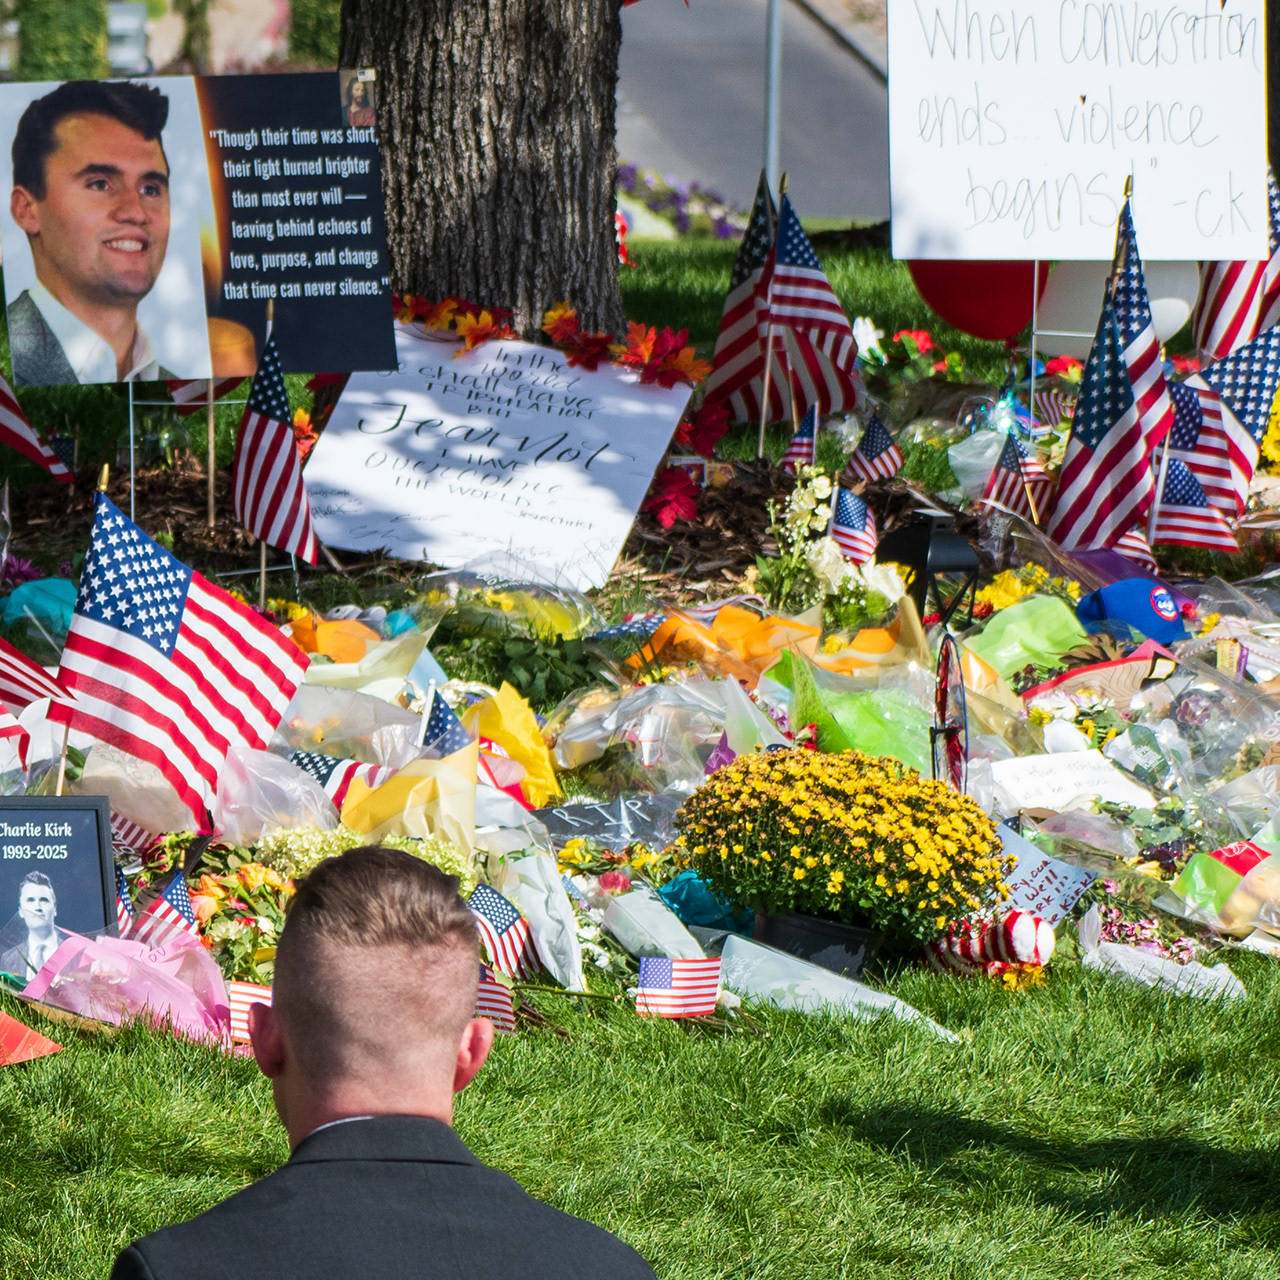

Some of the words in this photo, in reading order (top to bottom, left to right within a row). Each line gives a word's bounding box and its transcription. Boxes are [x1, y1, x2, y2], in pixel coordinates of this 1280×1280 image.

[913, 0, 1038, 64] When
[1054, 84, 1219, 149] violence
[209, 129, 259, 150] "Though
[261, 127, 289, 147] their
[291, 127, 318, 146] time
[321, 128, 344, 145] was
[346, 126, 380, 146] short,
[223, 160, 251, 179] their
[253, 158, 281, 181] light
[283, 157, 323, 177] burned
[325, 156, 371, 179] brighter
[232, 190, 259, 209] than
[261, 189, 290, 207] most
[293, 189, 319, 206] ever
[321, 187, 342, 205] will
[231, 220, 275, 242] leaving
[276, 218, 315, 239] behind
[317, 217, 359, 236] echoes
[360, 216, 372, 235] of
[229, 251, 260, 271] love,
[261, 252, 312, 272] purpose,
[314, 248, 336, 267] and
[338, 247, 379, 269] change
[223, 282, 249, 301] that
[251, 280, 277, 299] time
[279, 282, 301, 298] can
[303, 280, 337, 297] never
[339, 276, 390, 296] silence."
[418, 363, 499, 393] shall
[427, 382, 593, 420] TRIBULATION
[467, 403, 512, 420] BUT
[466, 453, 528, 473] HAVE
[394, 475, 438, 491] THE
[44, 822, 72, 837] Kirk
[2, 845, 68, 859] 1993-2025
